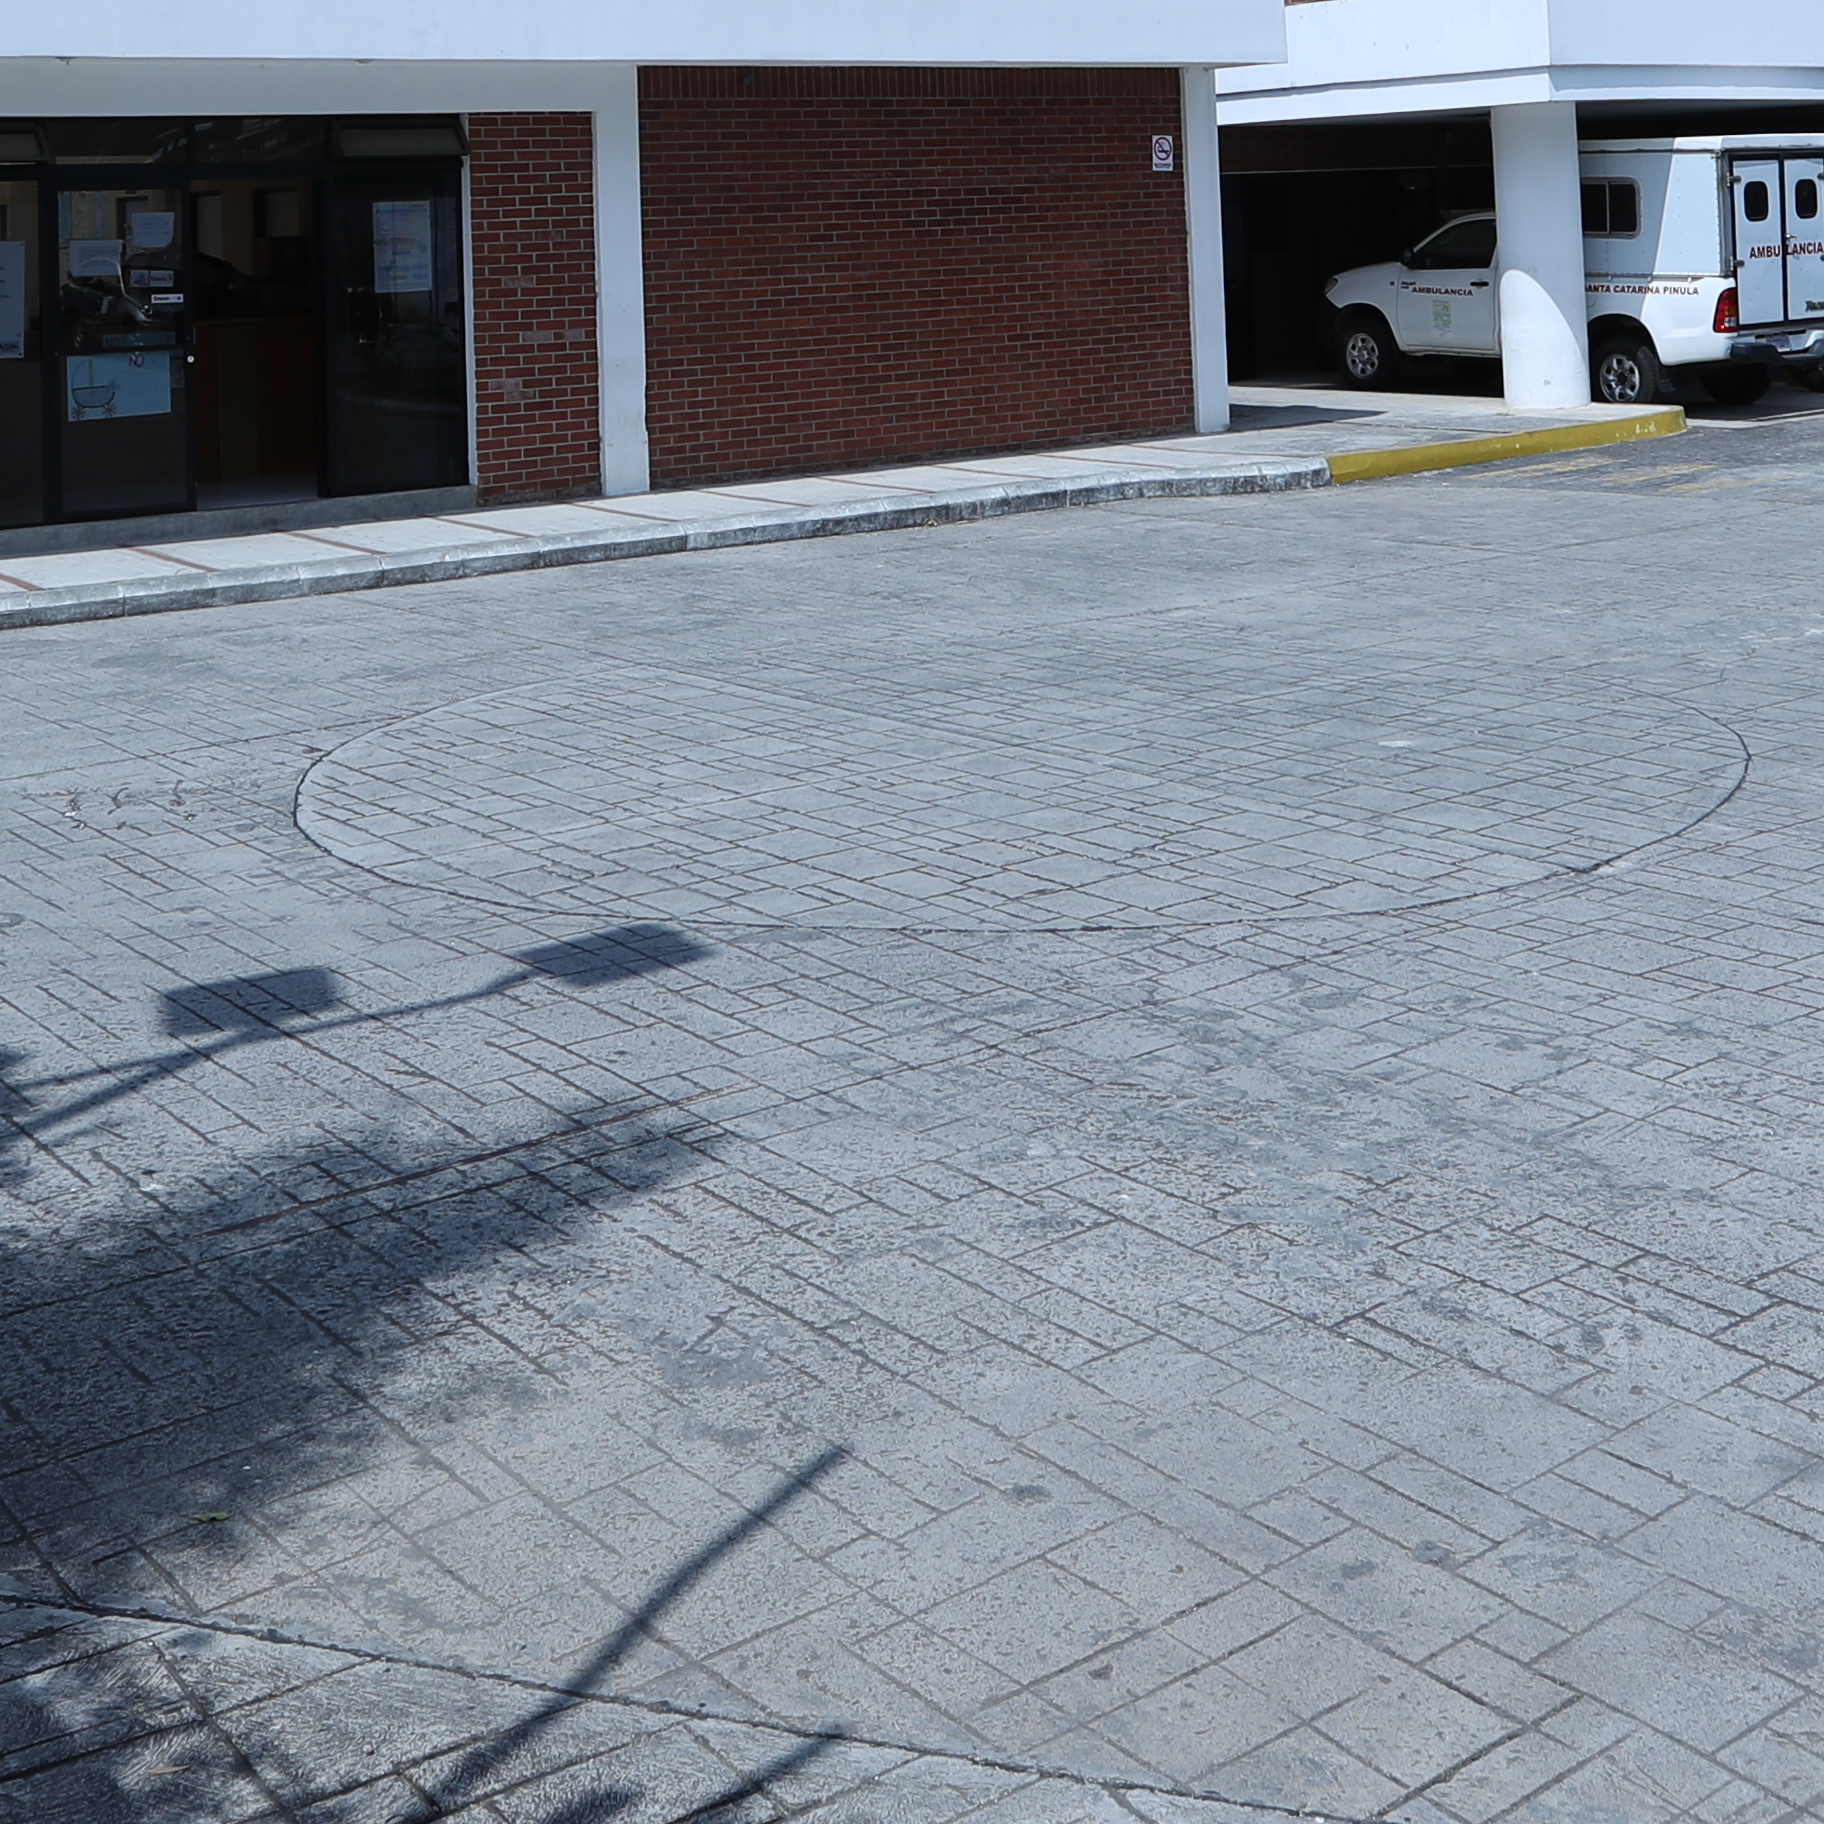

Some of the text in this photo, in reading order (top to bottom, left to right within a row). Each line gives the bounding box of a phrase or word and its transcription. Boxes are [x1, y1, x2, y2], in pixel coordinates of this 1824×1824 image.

[1749, 241, 1824, 259] AMBULANCIA
[1411, 286, 1474, 297] AMBULANCIA
[1613, 285, 1660, 295] CATARINA
[1663, 286, 1699, 296] PINULA
